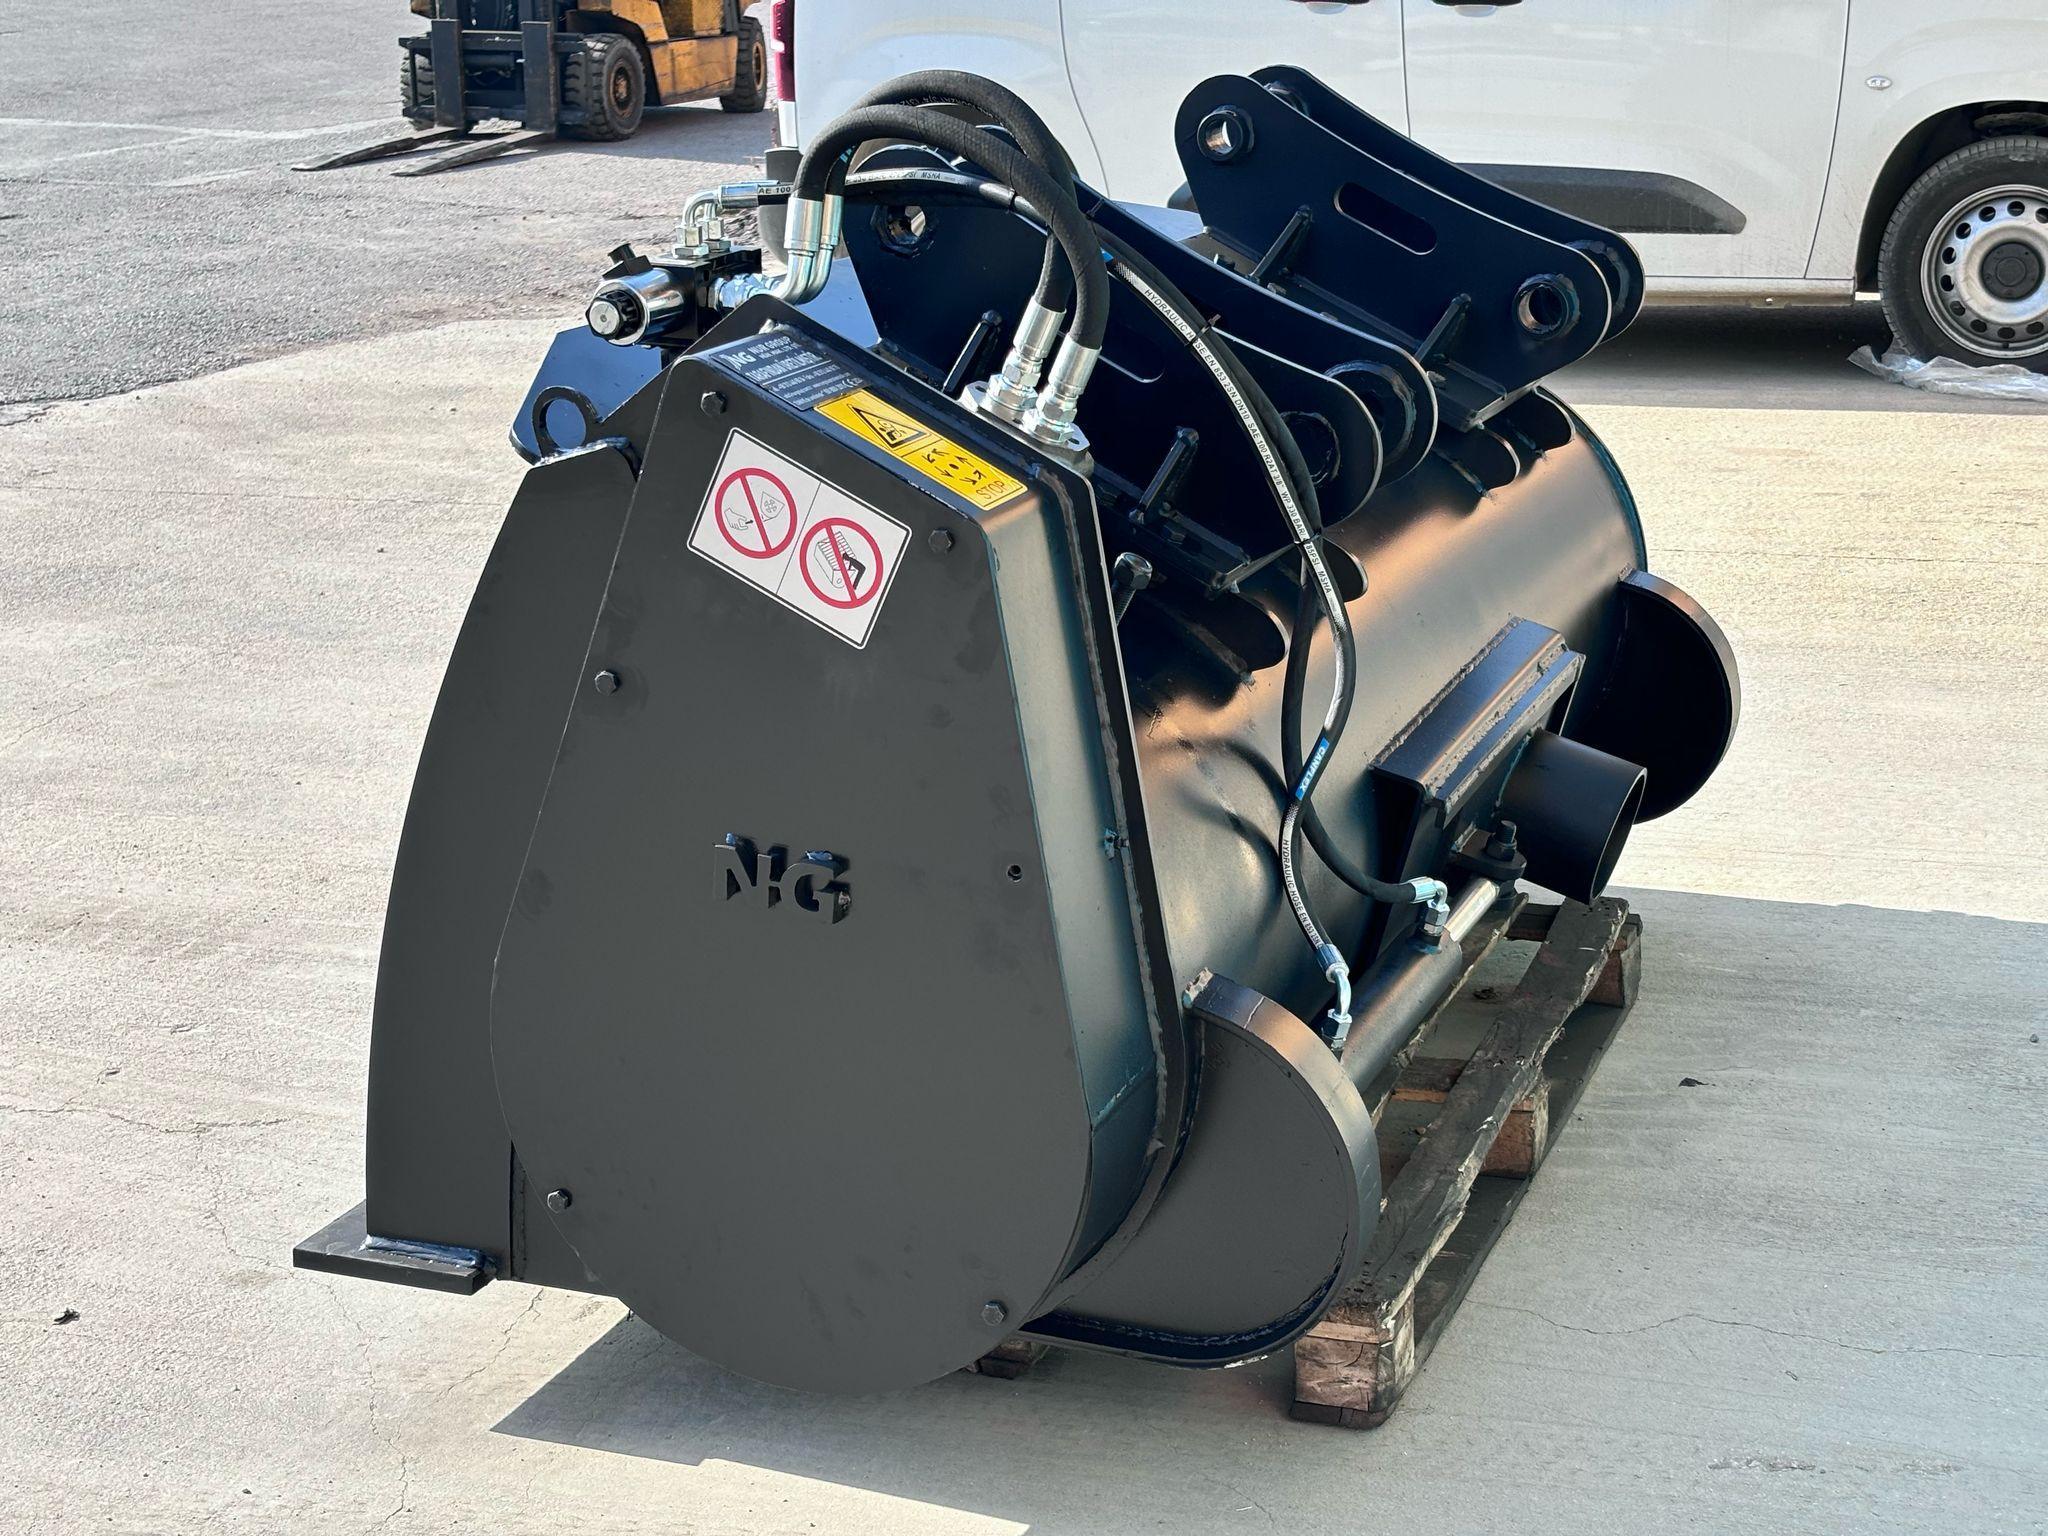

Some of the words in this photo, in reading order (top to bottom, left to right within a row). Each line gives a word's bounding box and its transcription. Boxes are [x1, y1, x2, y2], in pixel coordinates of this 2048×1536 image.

[1144, 289, 1188, 332] HYDRAULIC
[765, 335, 793, 349] GROUP
[1186, 331, 1207, 354] HSE
[1204, 354, 1217, 367] EN
[1223, 382, 1238, 398] 2SN
[1234, 398, 1250, 420] DN10
[1247, 422, 1261, 439] SAE
[1256, 440, 1267, 453] 100
[1263, 453, 1278, 473] R2AT
[975, 480, 1007, 500] STOP
[1281, 491, 1292, 504] WP
[1286, 503, 1298, 517] 330
[1318, 570, 1332, 593] MSHA
[1299, 747, 1326, 792] CANFLEX
[1282, 839, 1295, 889] HYDRAULIC
[1289, 890, 1304, 912] HOSE
[1299, 912, 1308, 923] EN
